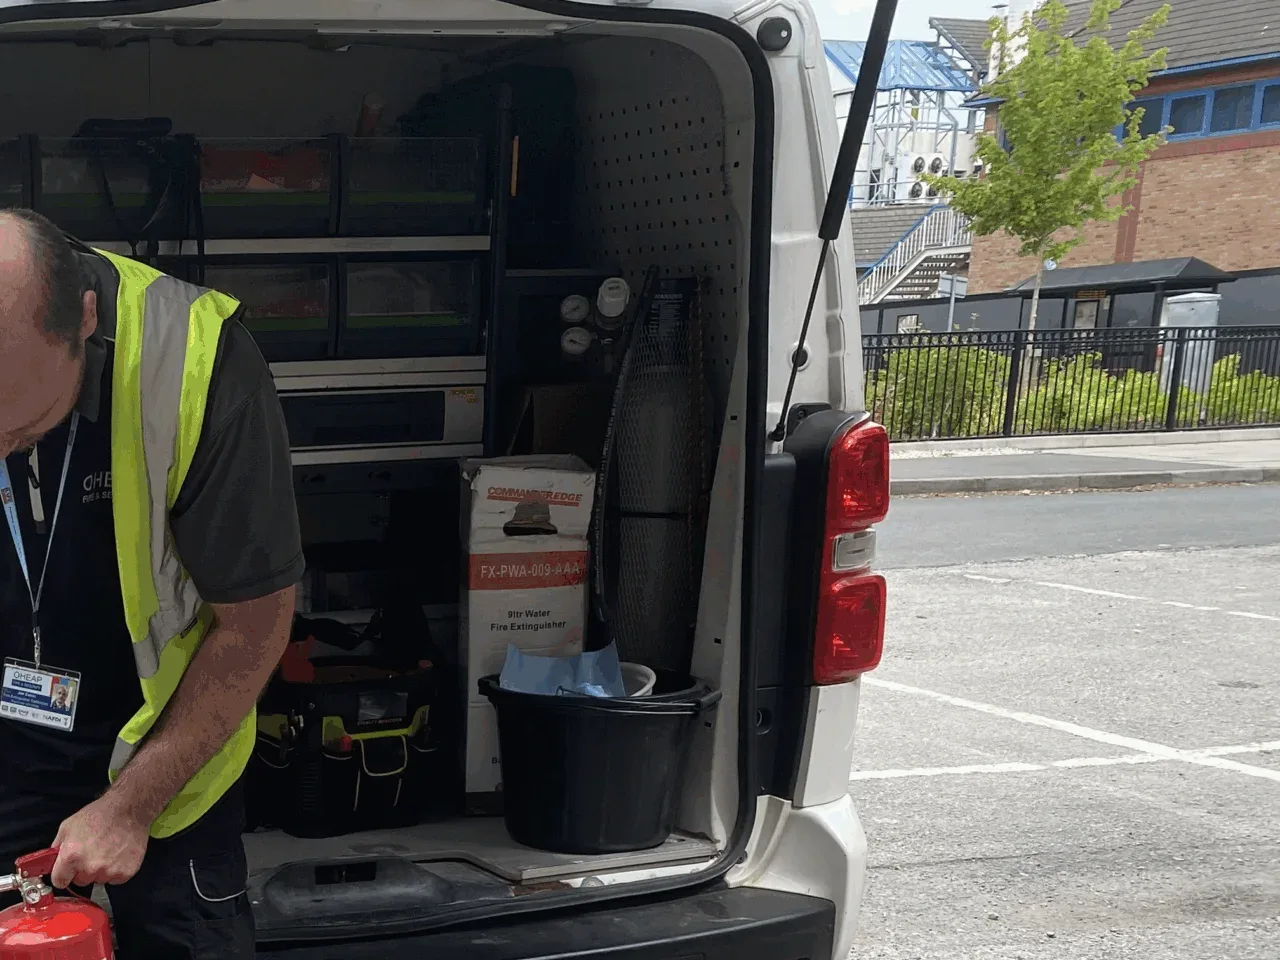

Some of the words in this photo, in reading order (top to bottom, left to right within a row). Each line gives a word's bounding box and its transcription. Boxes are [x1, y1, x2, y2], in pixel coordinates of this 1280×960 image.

[481, 562, 580, 579] FX-PWA-009-AAA
[525, 610, 550, 618] Water
[490, 623, 508, 631] Fire
[510, 621, 566, 632] Extinguisher
[14, 671, 42, 683] OHEAP
